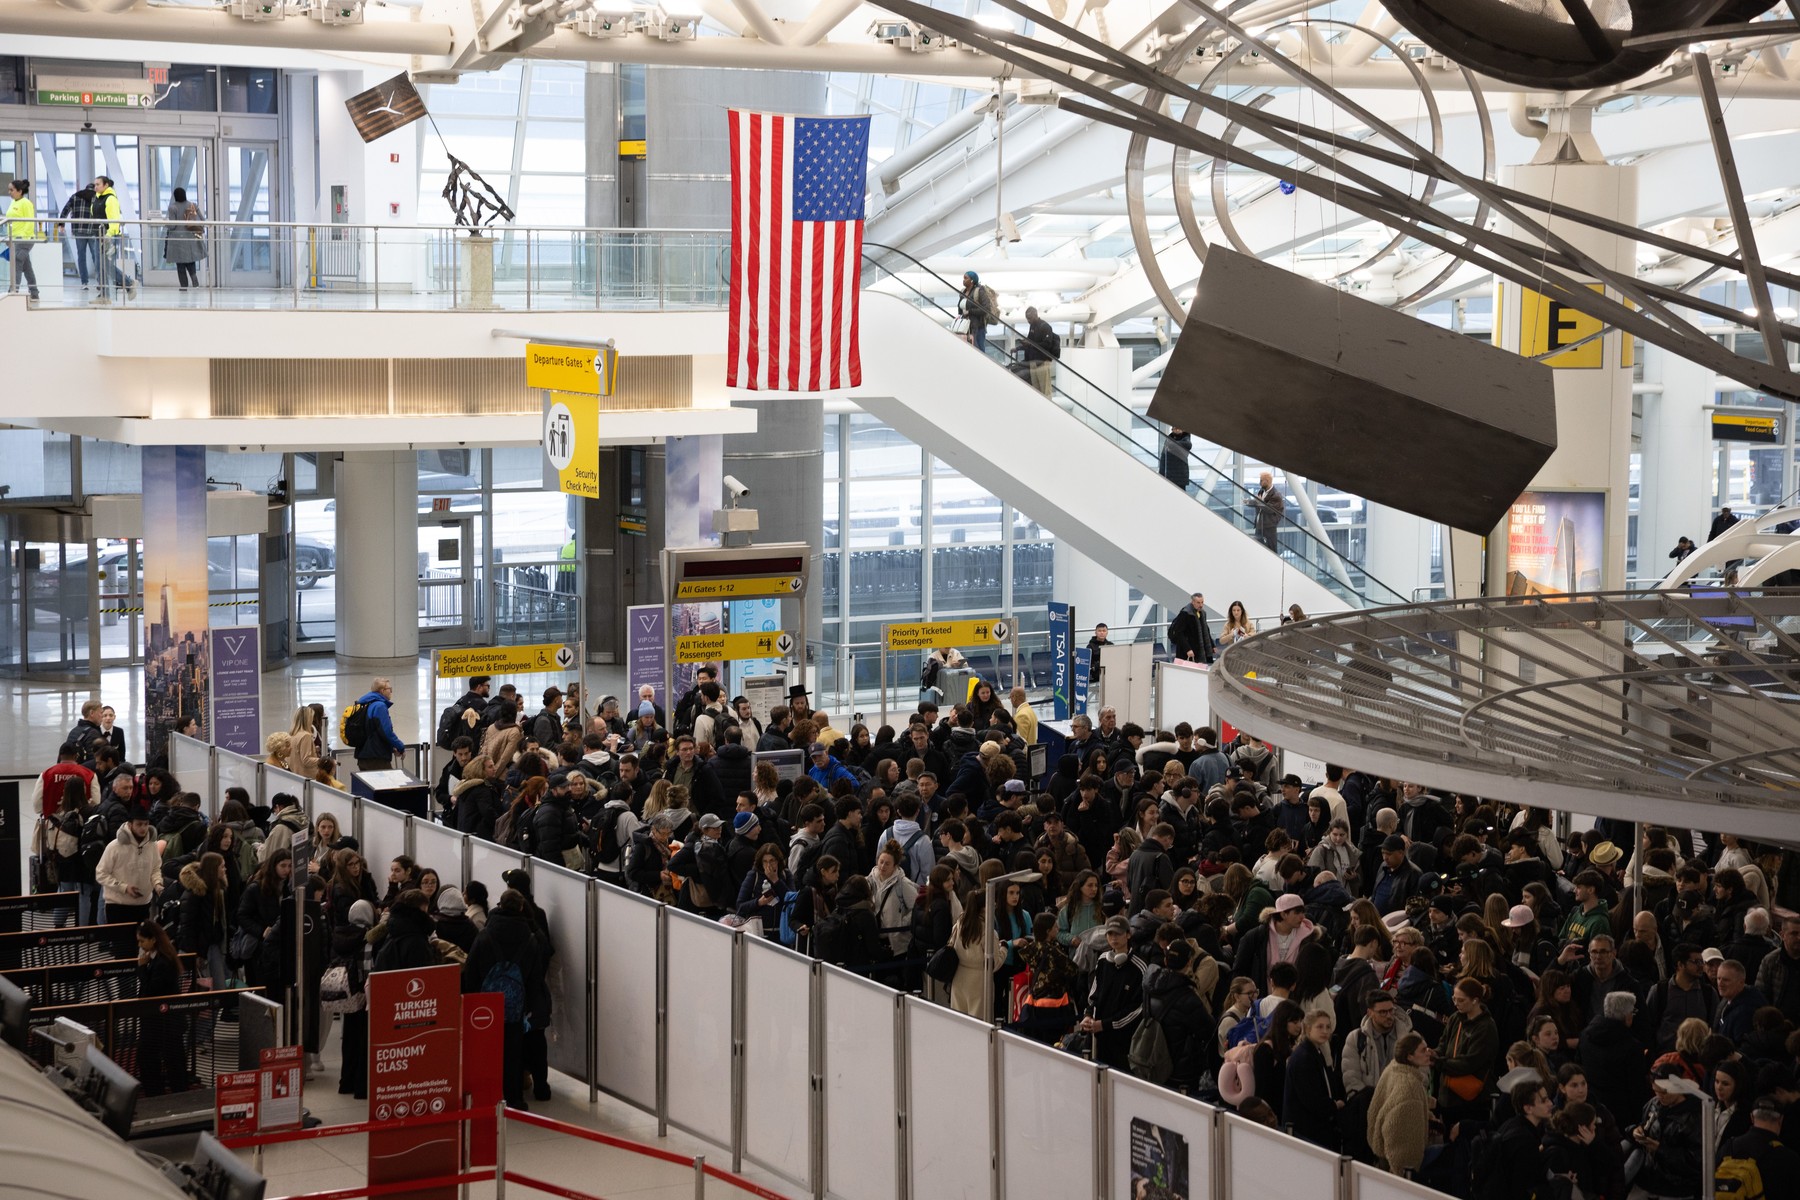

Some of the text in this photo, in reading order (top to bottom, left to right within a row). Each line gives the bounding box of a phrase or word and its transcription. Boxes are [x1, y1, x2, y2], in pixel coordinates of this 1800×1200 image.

[148, 68, 167, 84] EXIT
[50, 93, 126, 104] Parking 8 AirTrain
[1548, 301, 1577, 351] E
[533, 353, 583, 368] Departure Gates
[575, 468, 598, 482] Security
[566, 480, 598, 494] Check Point
[1532, 504, 1546, 514] FIND
[1512, 514, 1523, 524] THE
[1538, 514, 1546, 524] OF
[1524, 525, 1531, 534] AT
[1533, 525, 1543, 534] THE
[1511, 535, 1531, 544] WORLD
[1510, 545, 1558, 555] CENTER CAMPUS
[681, 584, 735, 593] All Gates 1-12
[892, 626, 952, 637] Priority Ticketed
[680, 640, 724, 650] All Ticketed
[892, 637, 933, 646] Passengers
[1056, 631, 1066, 659] TSA
[443, 653, 507, 666] Special Assistance
[680, 650, 722, 660] Passengers
[443, 661, 532, 675] Flight Crew & Employees
[1056, 663, 1065, 687] Pre
[394, 998, 437, 1011] TURKISH
[393, 1008, 438, 1021] AIRLINES
[376, 1044, 426, 1062] ECONOMY
[376, 1059, 408, 1073] CLASS
[376, 1086, 452, 1100] Passengers Have Priority
